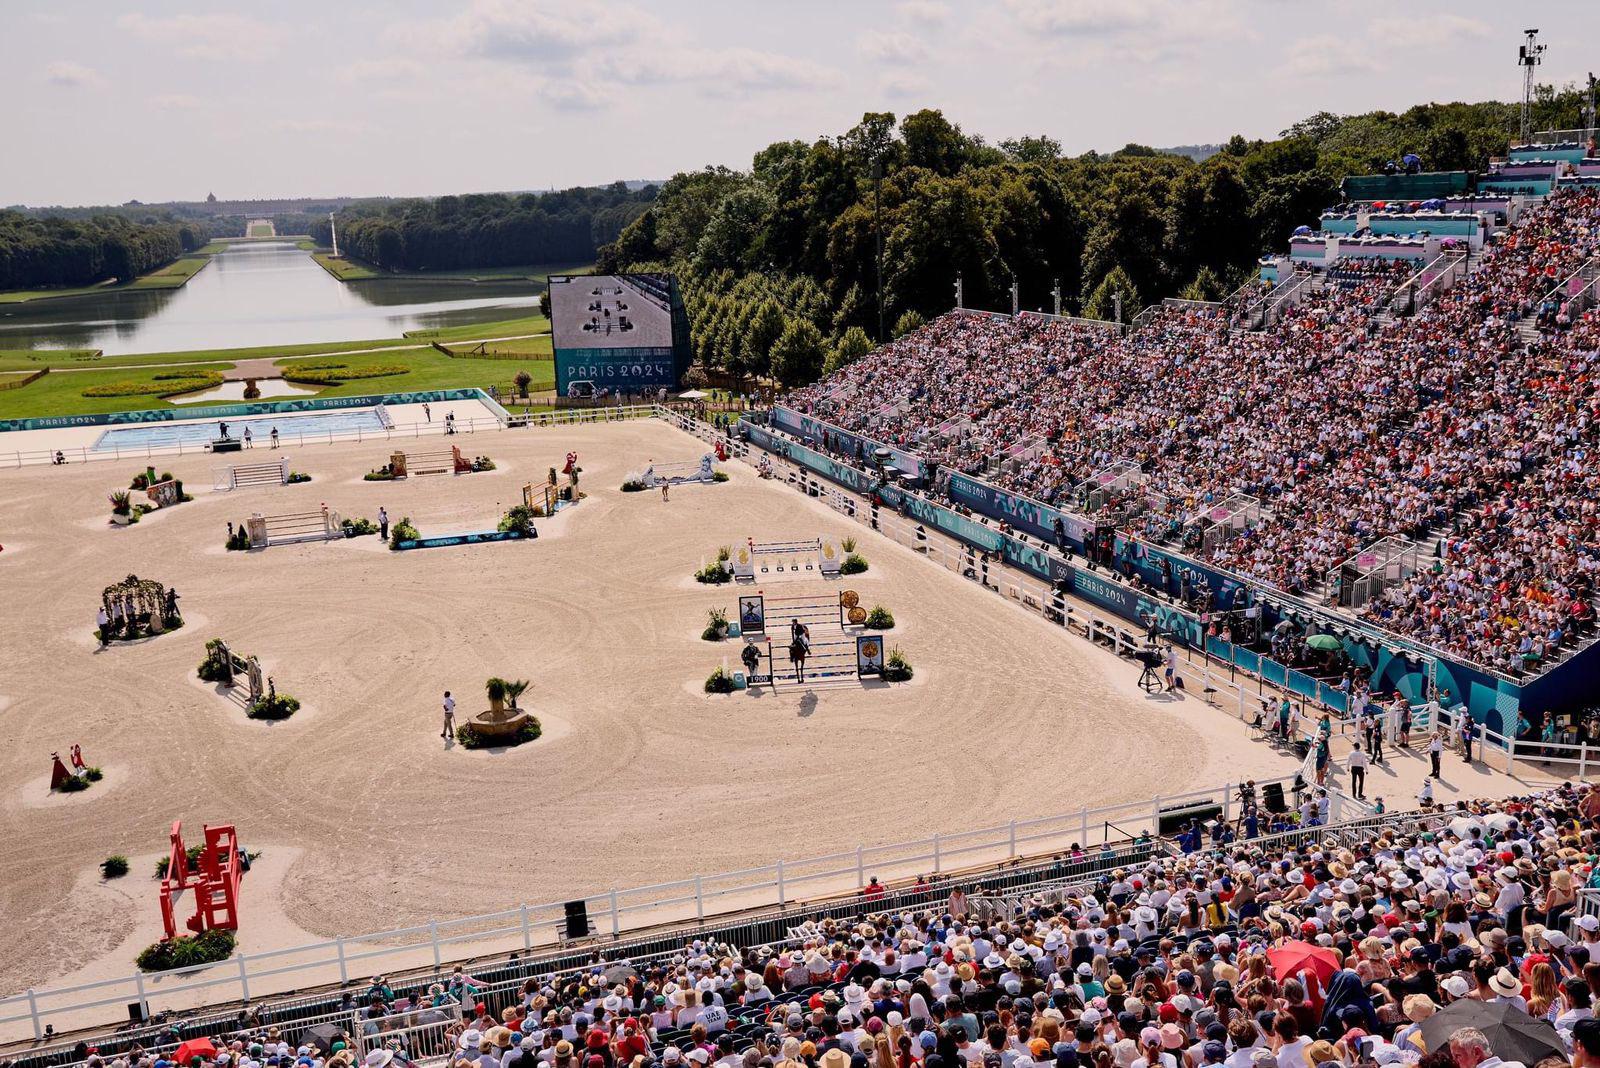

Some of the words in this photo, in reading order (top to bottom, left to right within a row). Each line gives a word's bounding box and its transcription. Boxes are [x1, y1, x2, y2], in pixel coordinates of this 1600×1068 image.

[568, 365, 615, 377] PARIS
[620, 364, 664, 376] 2024
[40, 418, 68, 426] PARIS
[956, 480, 972, 493] PARIS
[973, 487, 987, 499] 2024
[1082, 578, 1104, 595] PARIS
[1105, 587, 1126, 605] 2024
[750, 675, 768, 683] 1900
[705, 1010, 720, 1020] UAE
